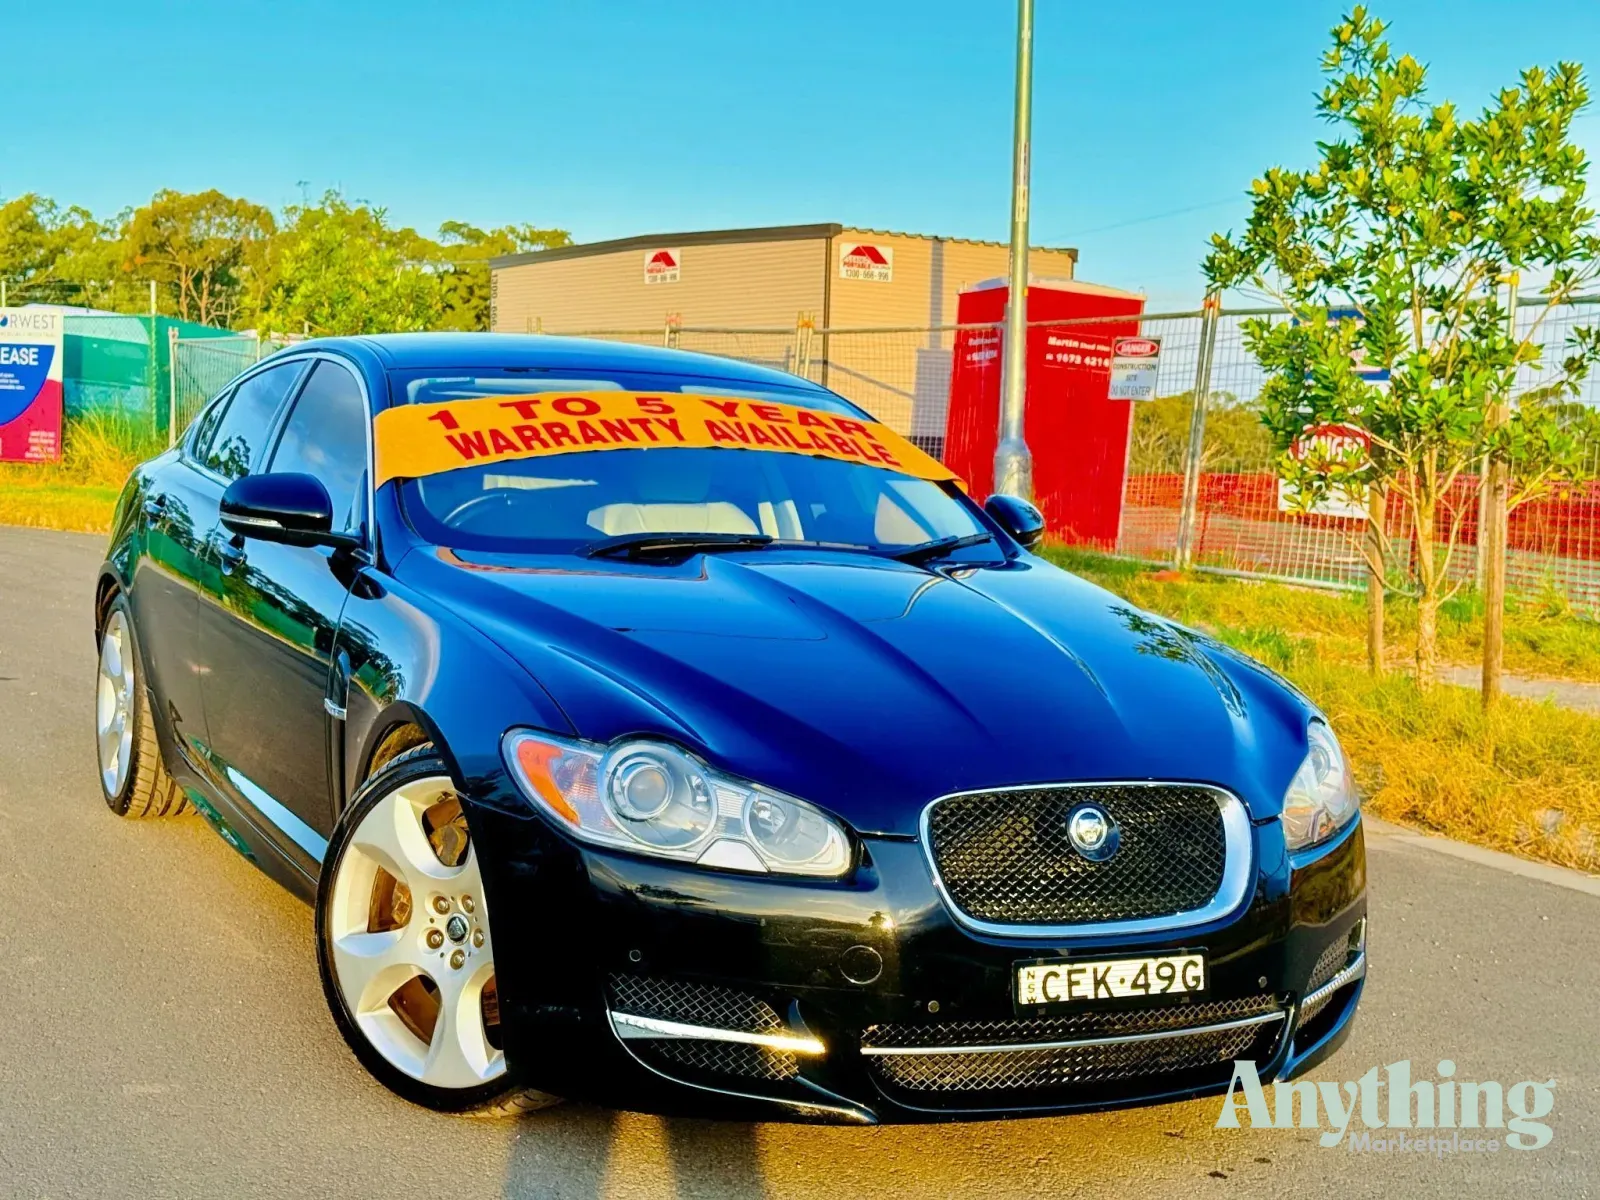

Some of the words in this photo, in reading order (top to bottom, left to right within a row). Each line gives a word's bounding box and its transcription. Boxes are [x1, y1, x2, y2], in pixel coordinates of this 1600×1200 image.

[0, 346, 39, 366] EASE
[1113, 363, 1156, 372] CONSTRUCTION
[1131, 386, 1151, 397] ENTER
[427, 410, 460, 430] 1
[498, 397, 601, 420] TO
[635, 397, 675, 415] 5
[700, 399, 878, 442] YEAR
[444, 417, 685, 460] WARRANTY
[703, 419, 903, 468] AVAILABLE
